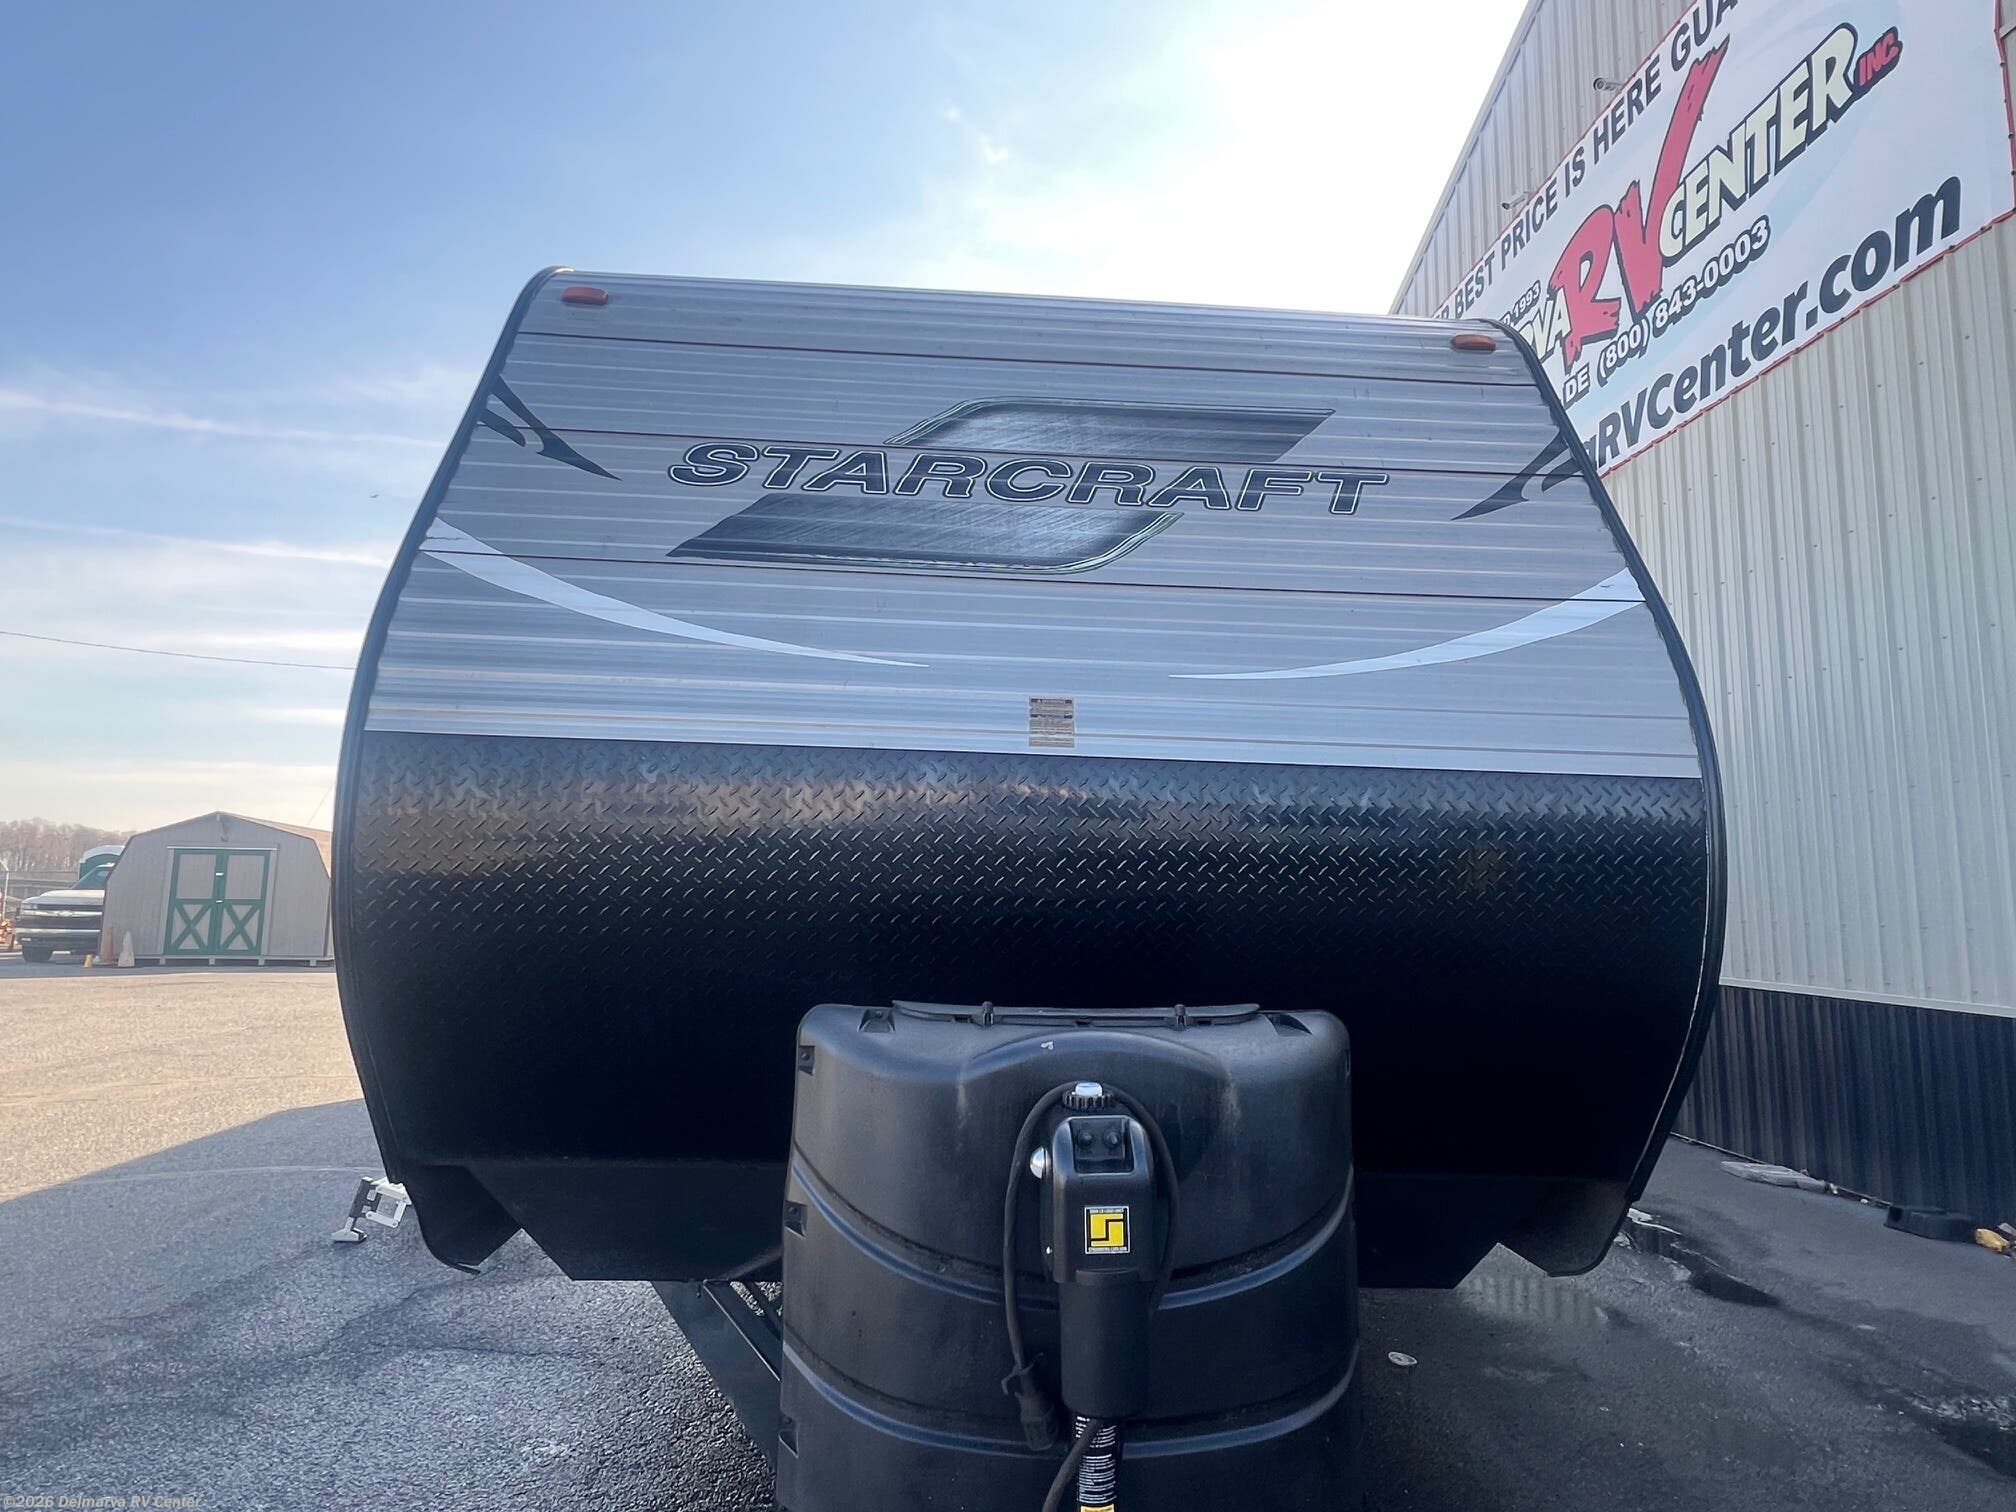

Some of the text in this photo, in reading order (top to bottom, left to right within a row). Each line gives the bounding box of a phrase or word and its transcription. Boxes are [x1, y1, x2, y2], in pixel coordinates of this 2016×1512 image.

[1454, 250, 1496, 320] BEST
[1501, 178, 1558, 271] PRICE
[1564, 146, 1586, 198] IS
[1593, 54, 1662, 166] HERE
[1548, 34, 1730, 370] RV
[1658, 22, 1857, 262] CENTER
[1512, 281, 1540, 320] 1993
[1564, 216, 1770, 406] DE (800) 843-0003
[668, 441, 1390, 515] STARCRAFT
